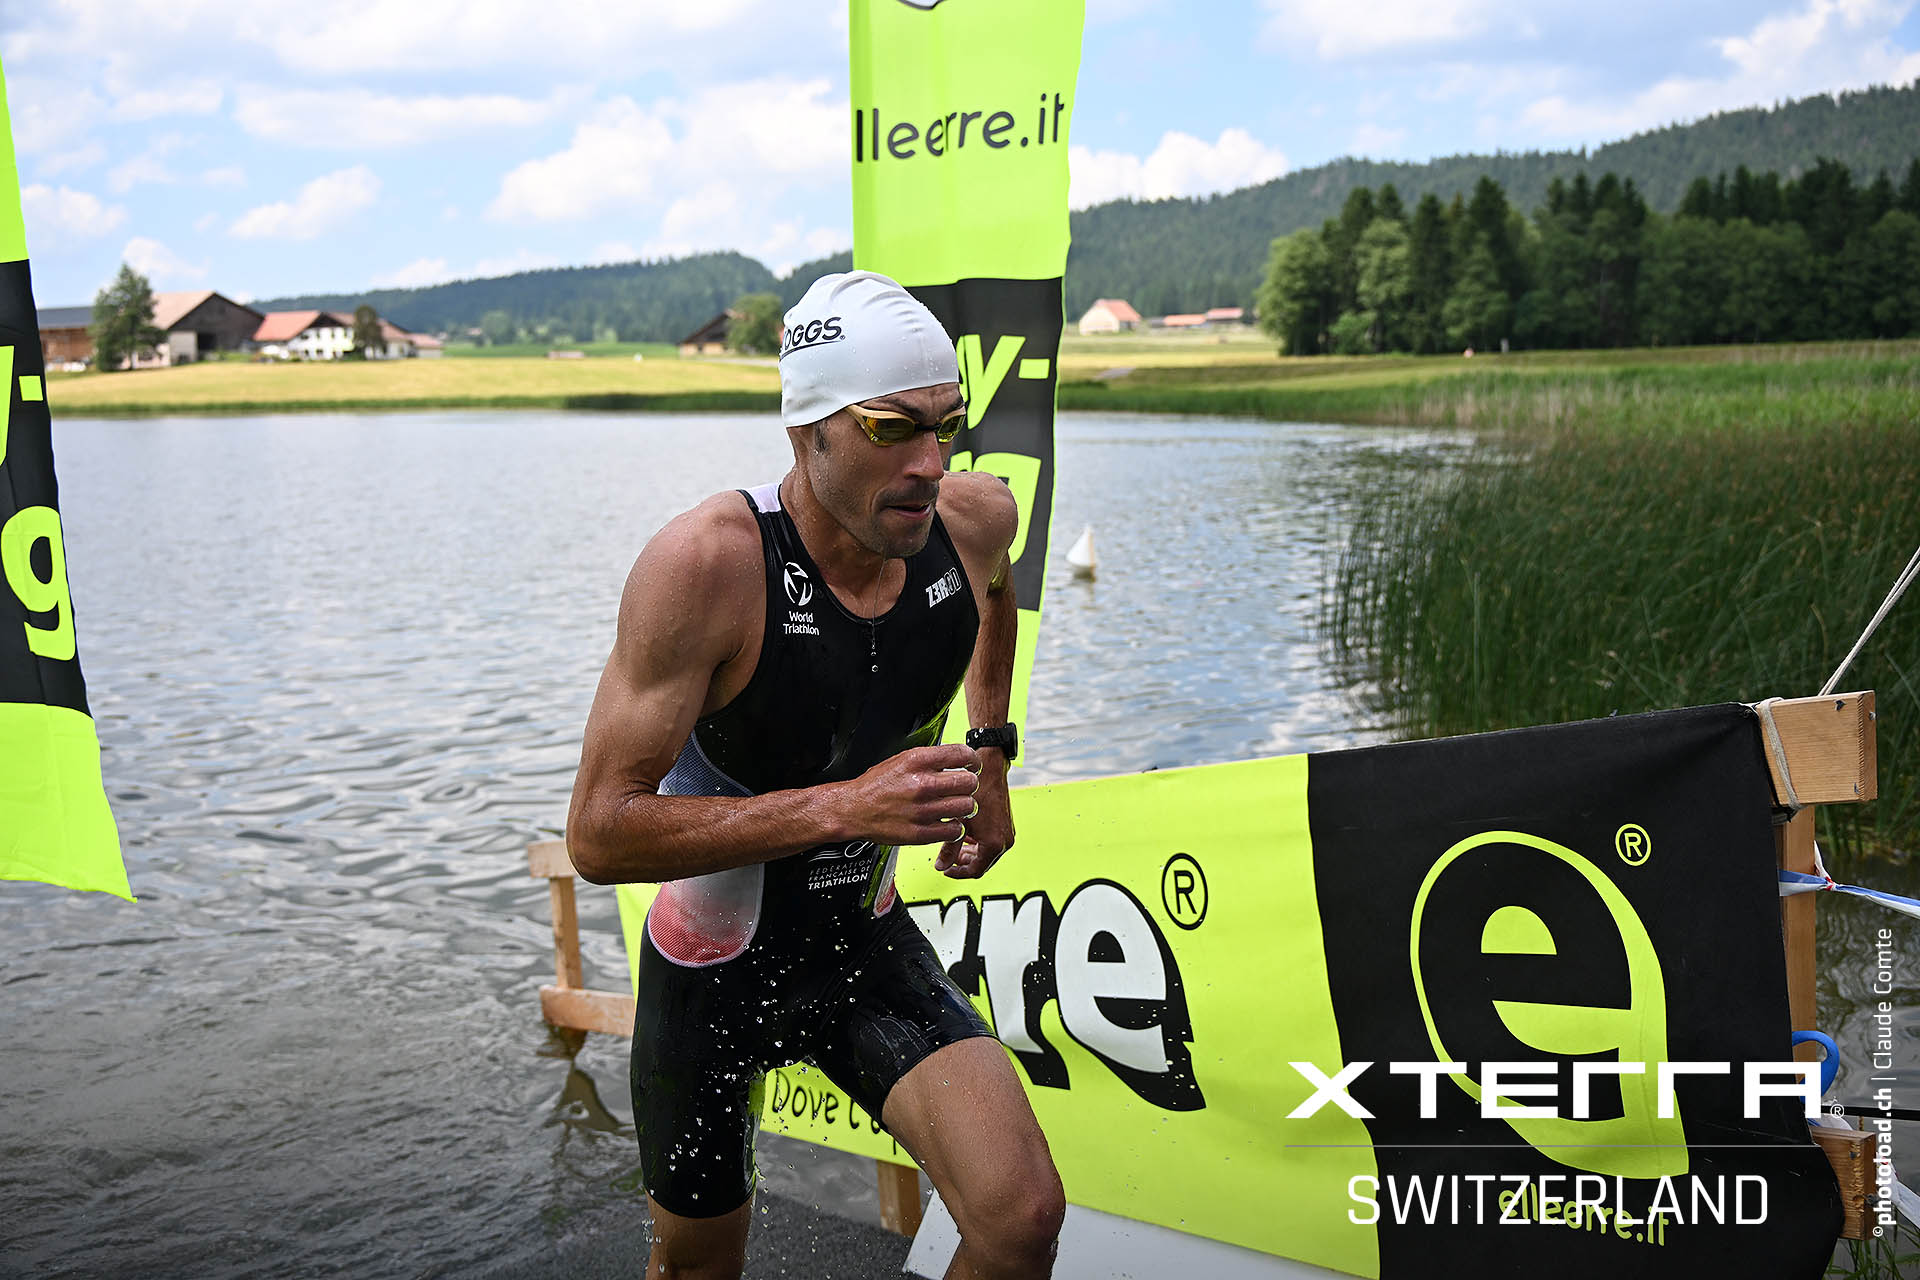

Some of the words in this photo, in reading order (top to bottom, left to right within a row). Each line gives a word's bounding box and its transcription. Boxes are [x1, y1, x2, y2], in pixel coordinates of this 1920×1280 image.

[788, 610, 814, 624] World
[782, 622, 820, 636] Triathlon
[860, 864, 872, 873] DE
[808, 873, 869, 891] TRIATHLON
[771, 1068, 839, 1125] Dove
